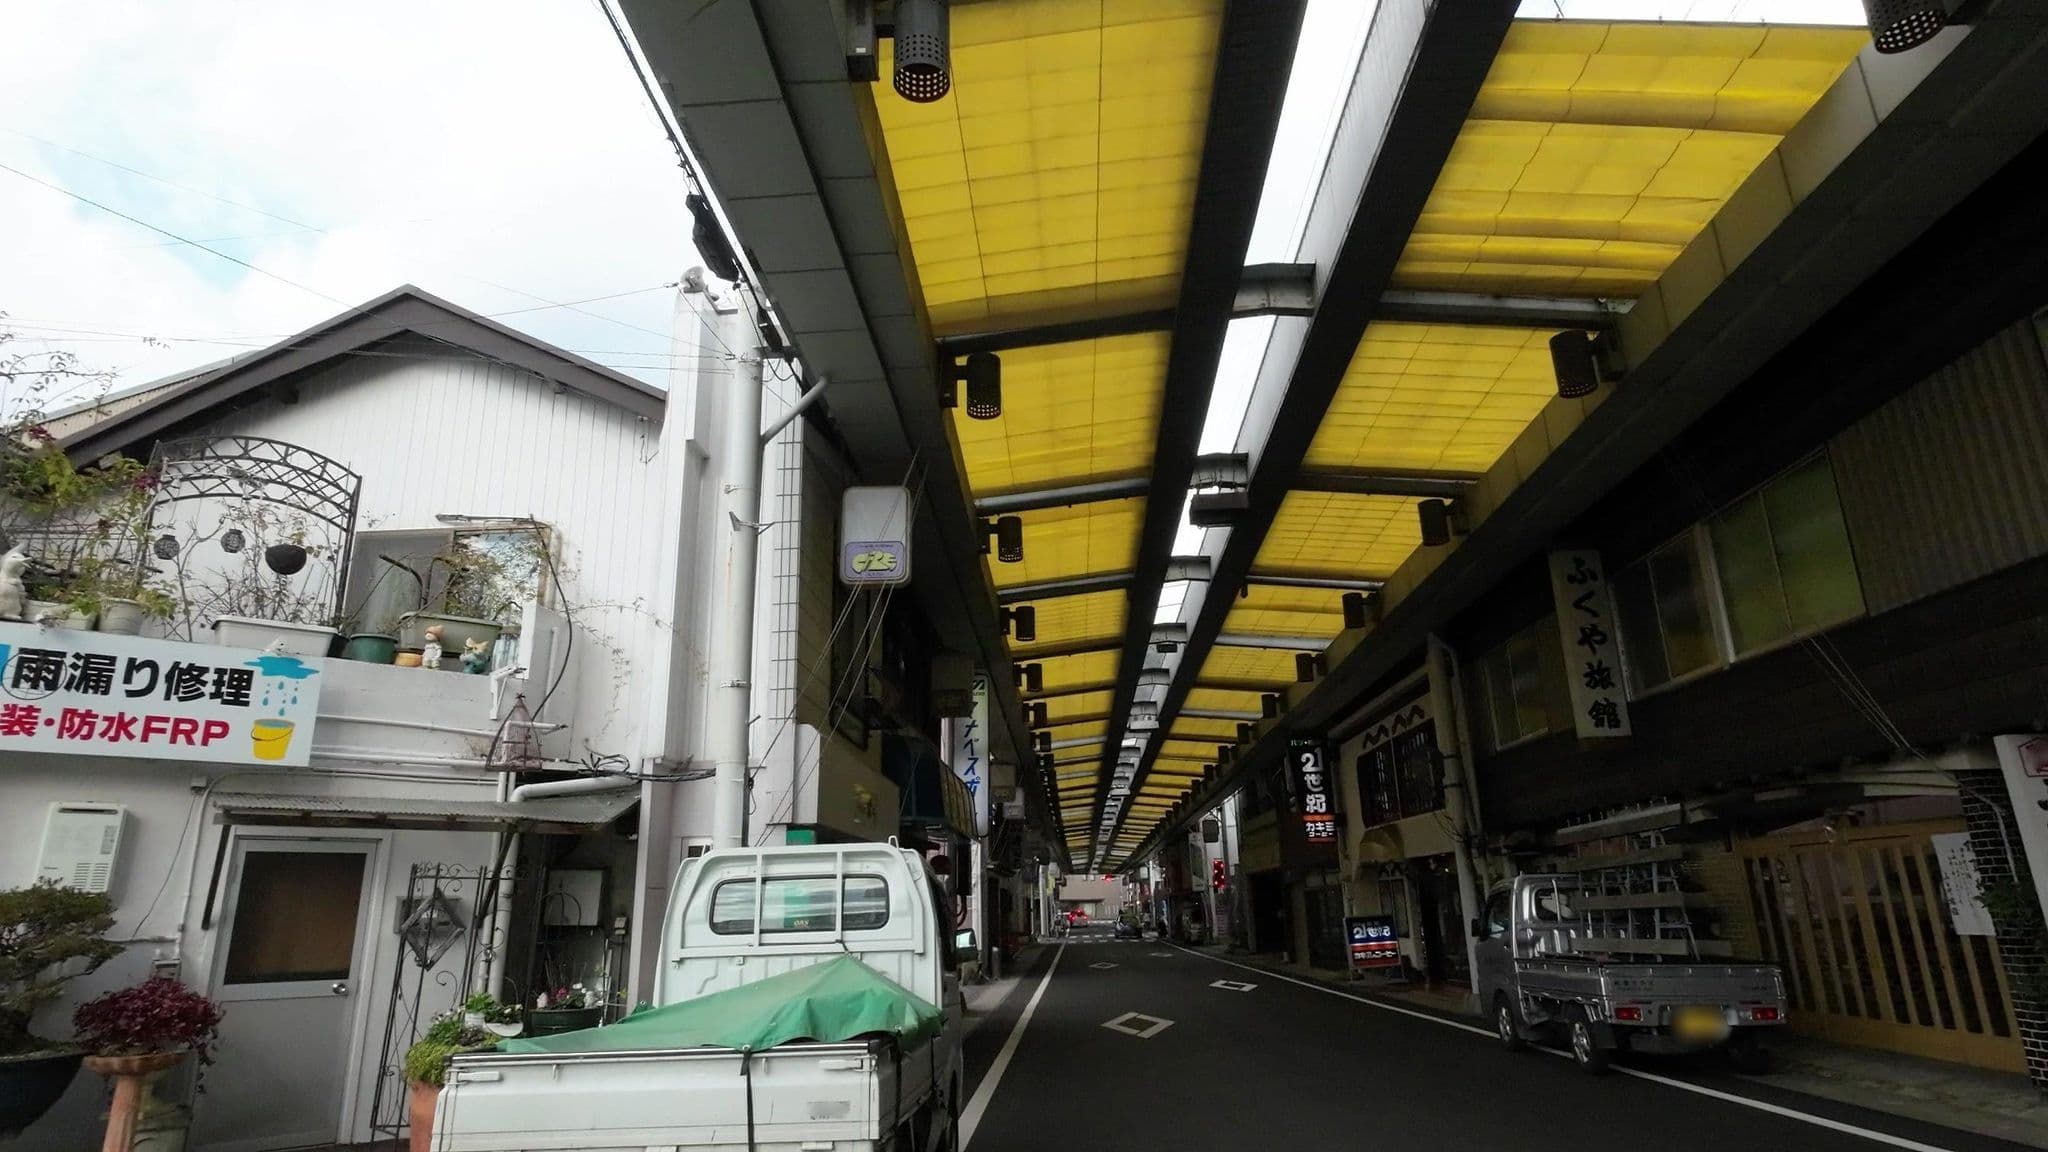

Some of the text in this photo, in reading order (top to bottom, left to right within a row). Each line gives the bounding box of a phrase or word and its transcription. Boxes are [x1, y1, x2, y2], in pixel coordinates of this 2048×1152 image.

[11, 647, 254, 707] 雨漏り修理
[1567, 556, 1621, 730] ふくや旅館
